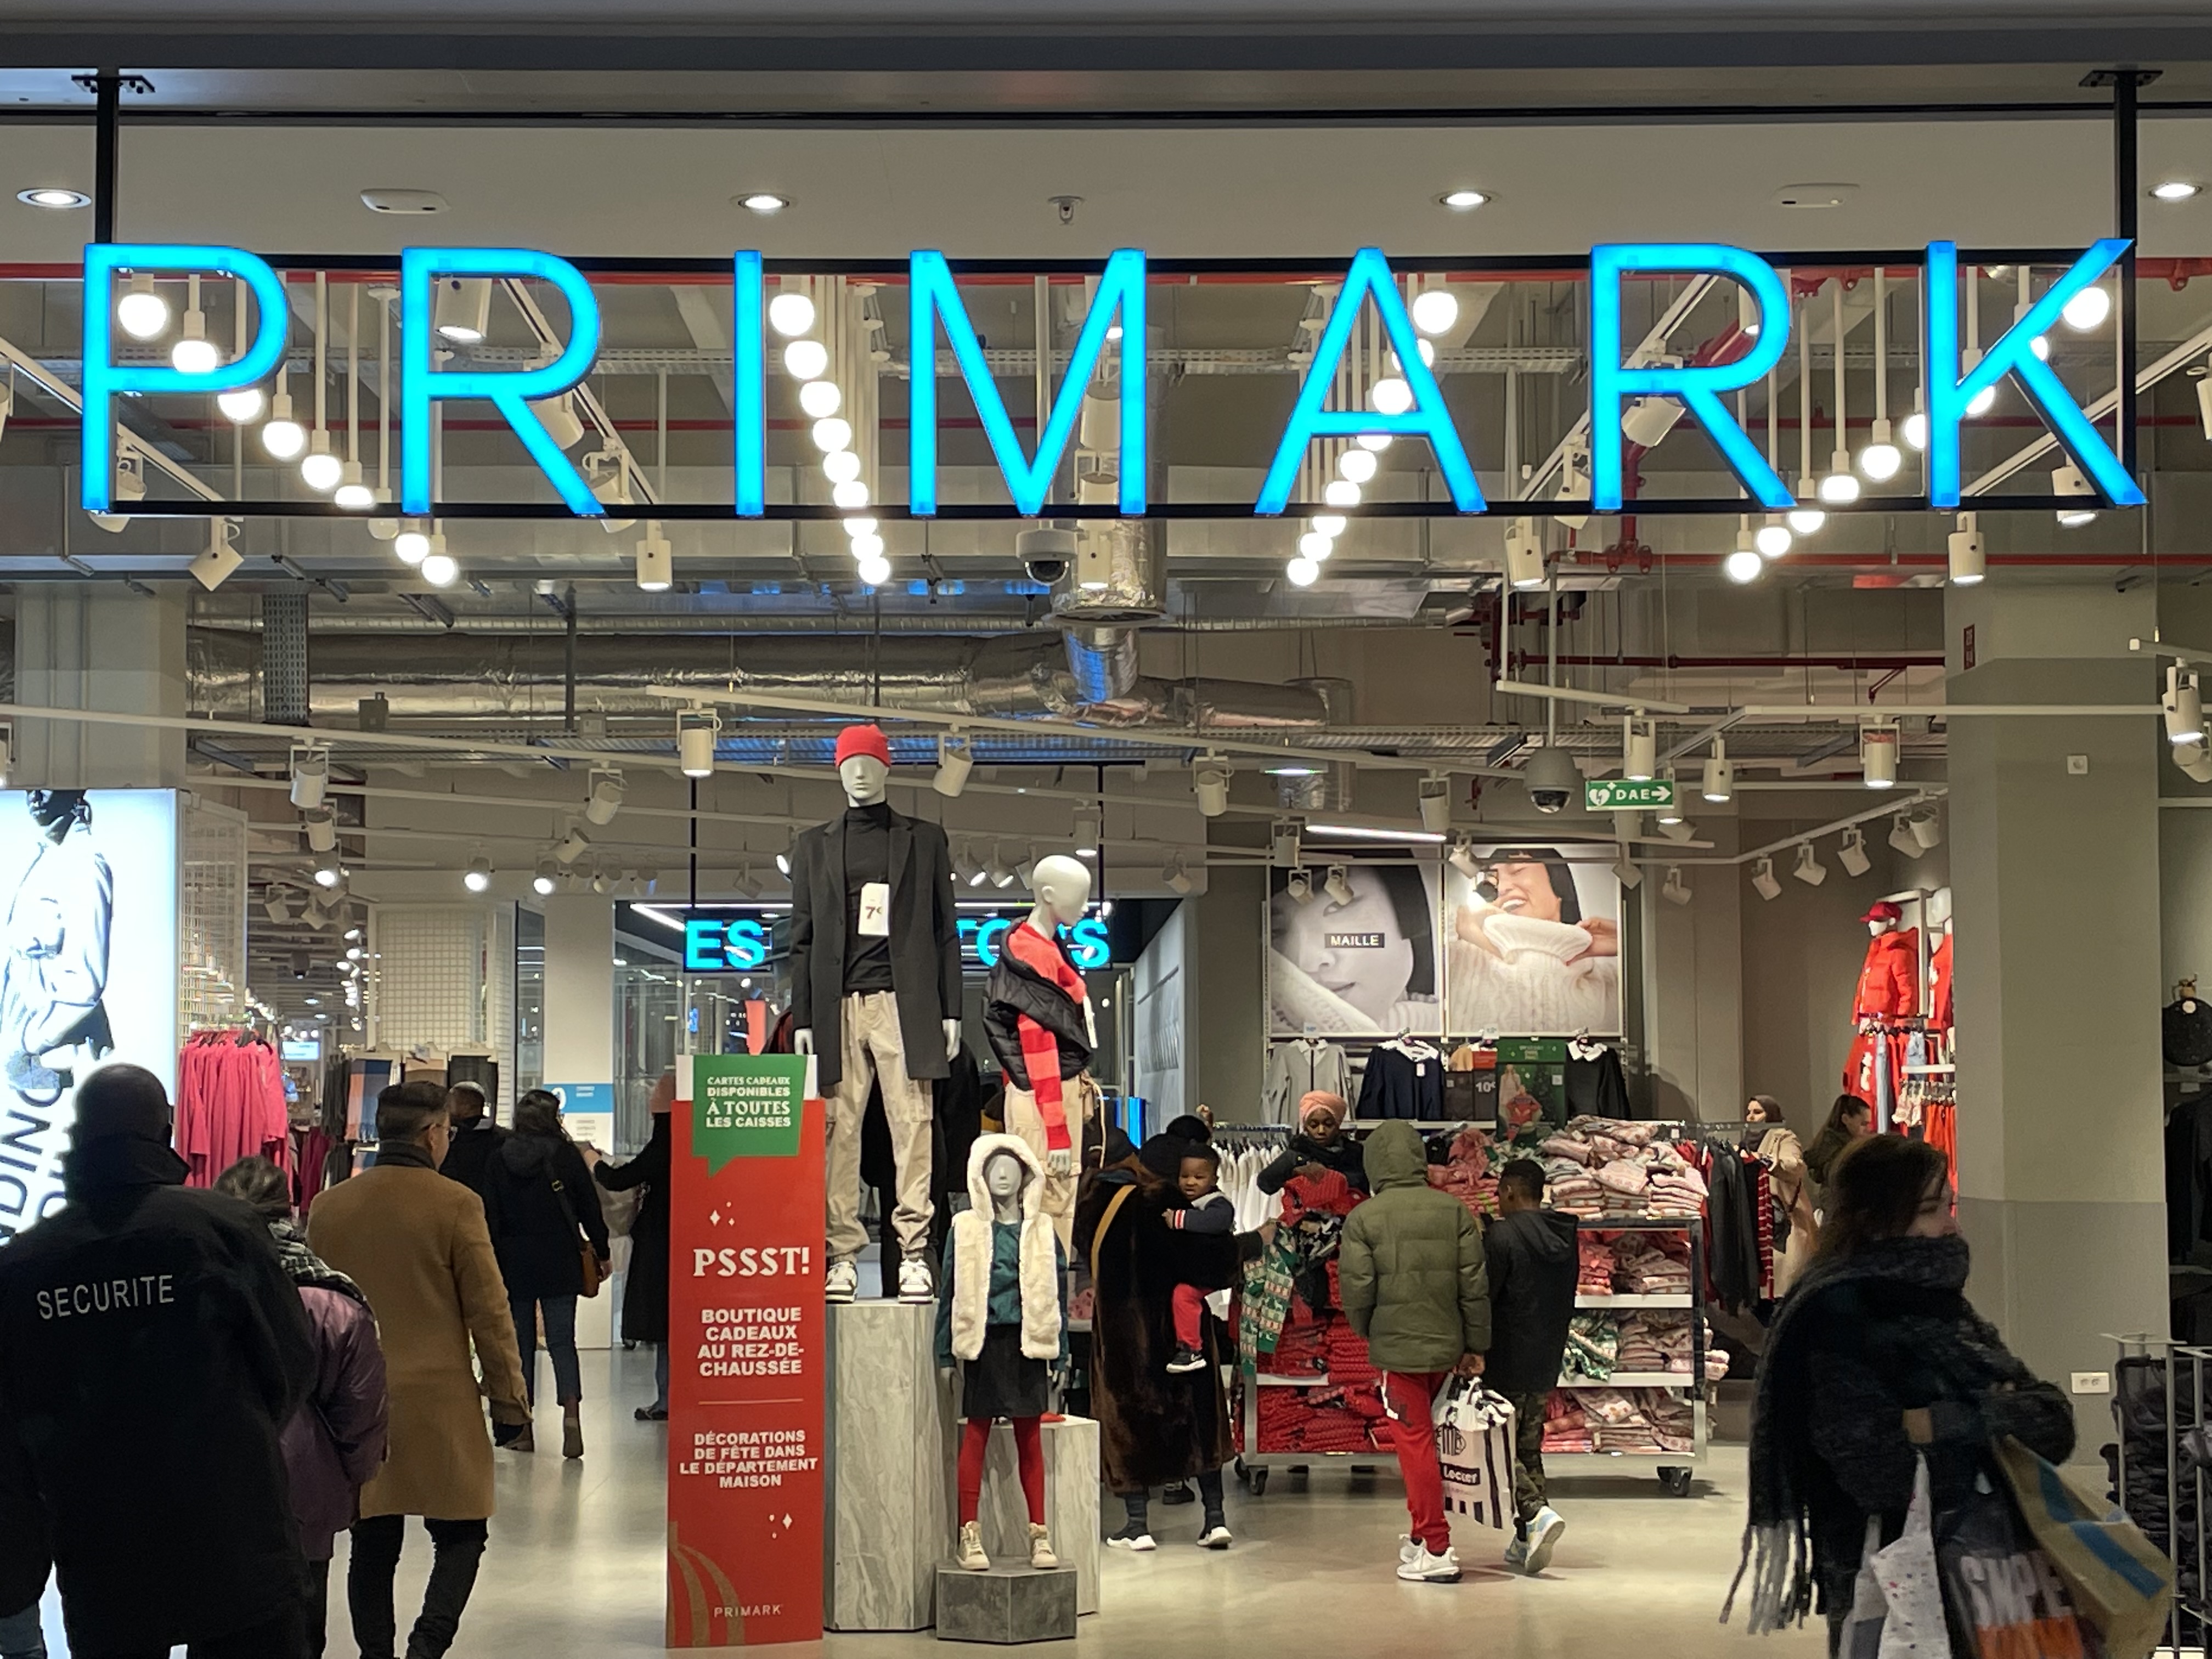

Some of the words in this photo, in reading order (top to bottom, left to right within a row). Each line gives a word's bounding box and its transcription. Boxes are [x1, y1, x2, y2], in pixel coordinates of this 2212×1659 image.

[81, 239, 2147, 517] PRIMARK
[1616, 789, 1650, 800] DAE
[1331, 935, 1379, 946] MAILLE
[707, 1087, 791, 1097] DISPONIBLES
[724, 1101, 791, 1115] TOUTES
[706, 1117, 731, 1127] LES
[735, 1117, 791, 1127] CAISSES
[693, 1247, 809, 1277] PSSST!
[36, 1275, 174, 1319] SECURITE
[701, 1307, 802, 1324] BOUTIQUE
[706, 1325, 797, 1341] CADEAUX
[697, 1344, 725, 1359] AU
[731, 1342, 804, 1358] REZ-DE-
[699, 1357, 802, 1376] CHAUSSÉE
[695, 1430, 805, 1446] DÉCORATIONS
[694, 1448, 715, 1460] DE
[721, 1445, 760, 1460] FÊTE
[765, 1445, 805, 1458] DANS
[680, 1462, 699, 1475] LE
[704, 1458, 818, 1474] DÉPARTEMENT
[719, 1475, 781, 1488] MAISON
[714, 1605, 782, 1618] PRIMARK
